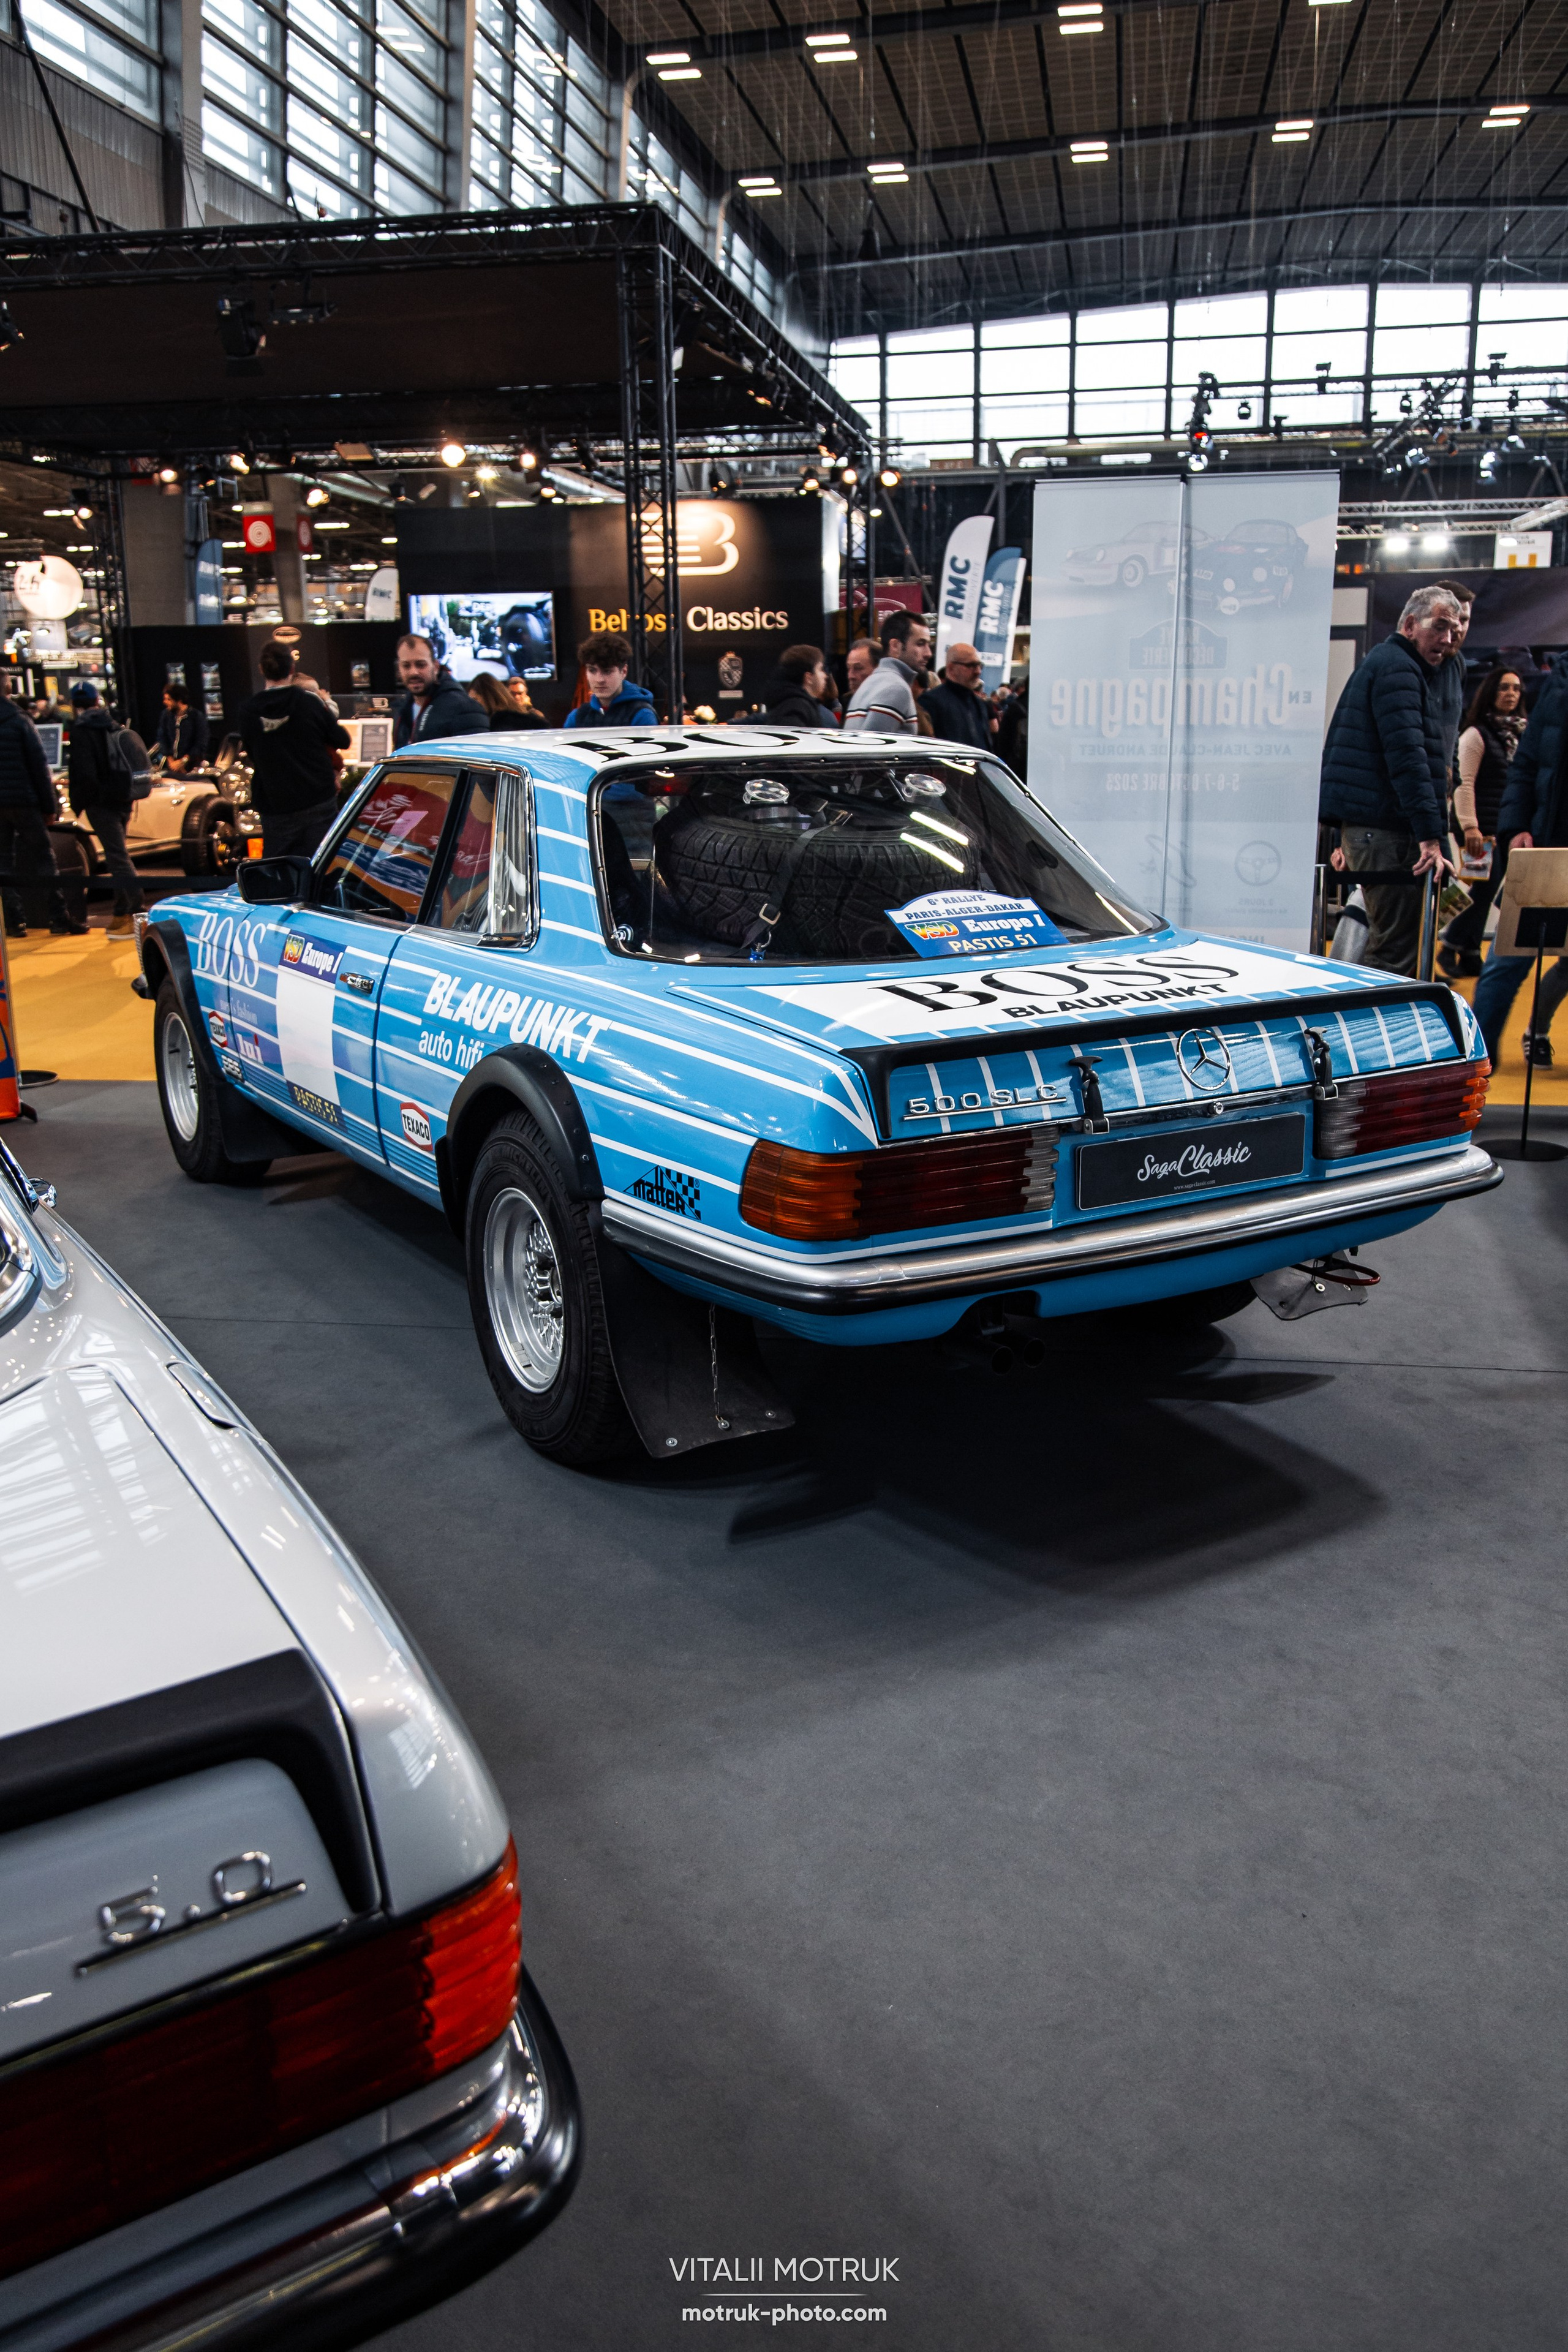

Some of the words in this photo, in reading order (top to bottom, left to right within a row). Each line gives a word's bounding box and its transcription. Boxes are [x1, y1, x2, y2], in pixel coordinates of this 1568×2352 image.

[944, 555, 970, 619] RMC
[687, 606, 789, 631] Classics
[979, 579, 1004, 634] RMC
[905, 903, 1025, 920] PARIS-ALGER-DAKAR
[942, 894, 986, 905] RALLYE
[905, 920, 960, 940] VSD
[962, 917, 1035, 933] Europe
[948, 936, 1014, 952] PASTIS
[1016, 933, 1038, 946] 51
[197, 913, 266, 987] BOSS
[284, 933, 305, 964] VSD
[301, 942, 335, 975] Europe
[868, 956, 1239, 1012] BOSS
[1001, 984, 1229, 1018] BLAUPUNKT
[423, 972, 613, 1063] BLAUPUNKT
[419, 1031, 452, 1061] auto
[455, 1035, 484, 1069] hifi
[293, 1086, 327, 1119] PASTIS
[910, 1093, 982, 1114] 500
[990, 1084, 1058, 1106] SLC
[402, 1114, 431, 1141] TEXACO
[100, 1850, 273, 1945] 5.0
